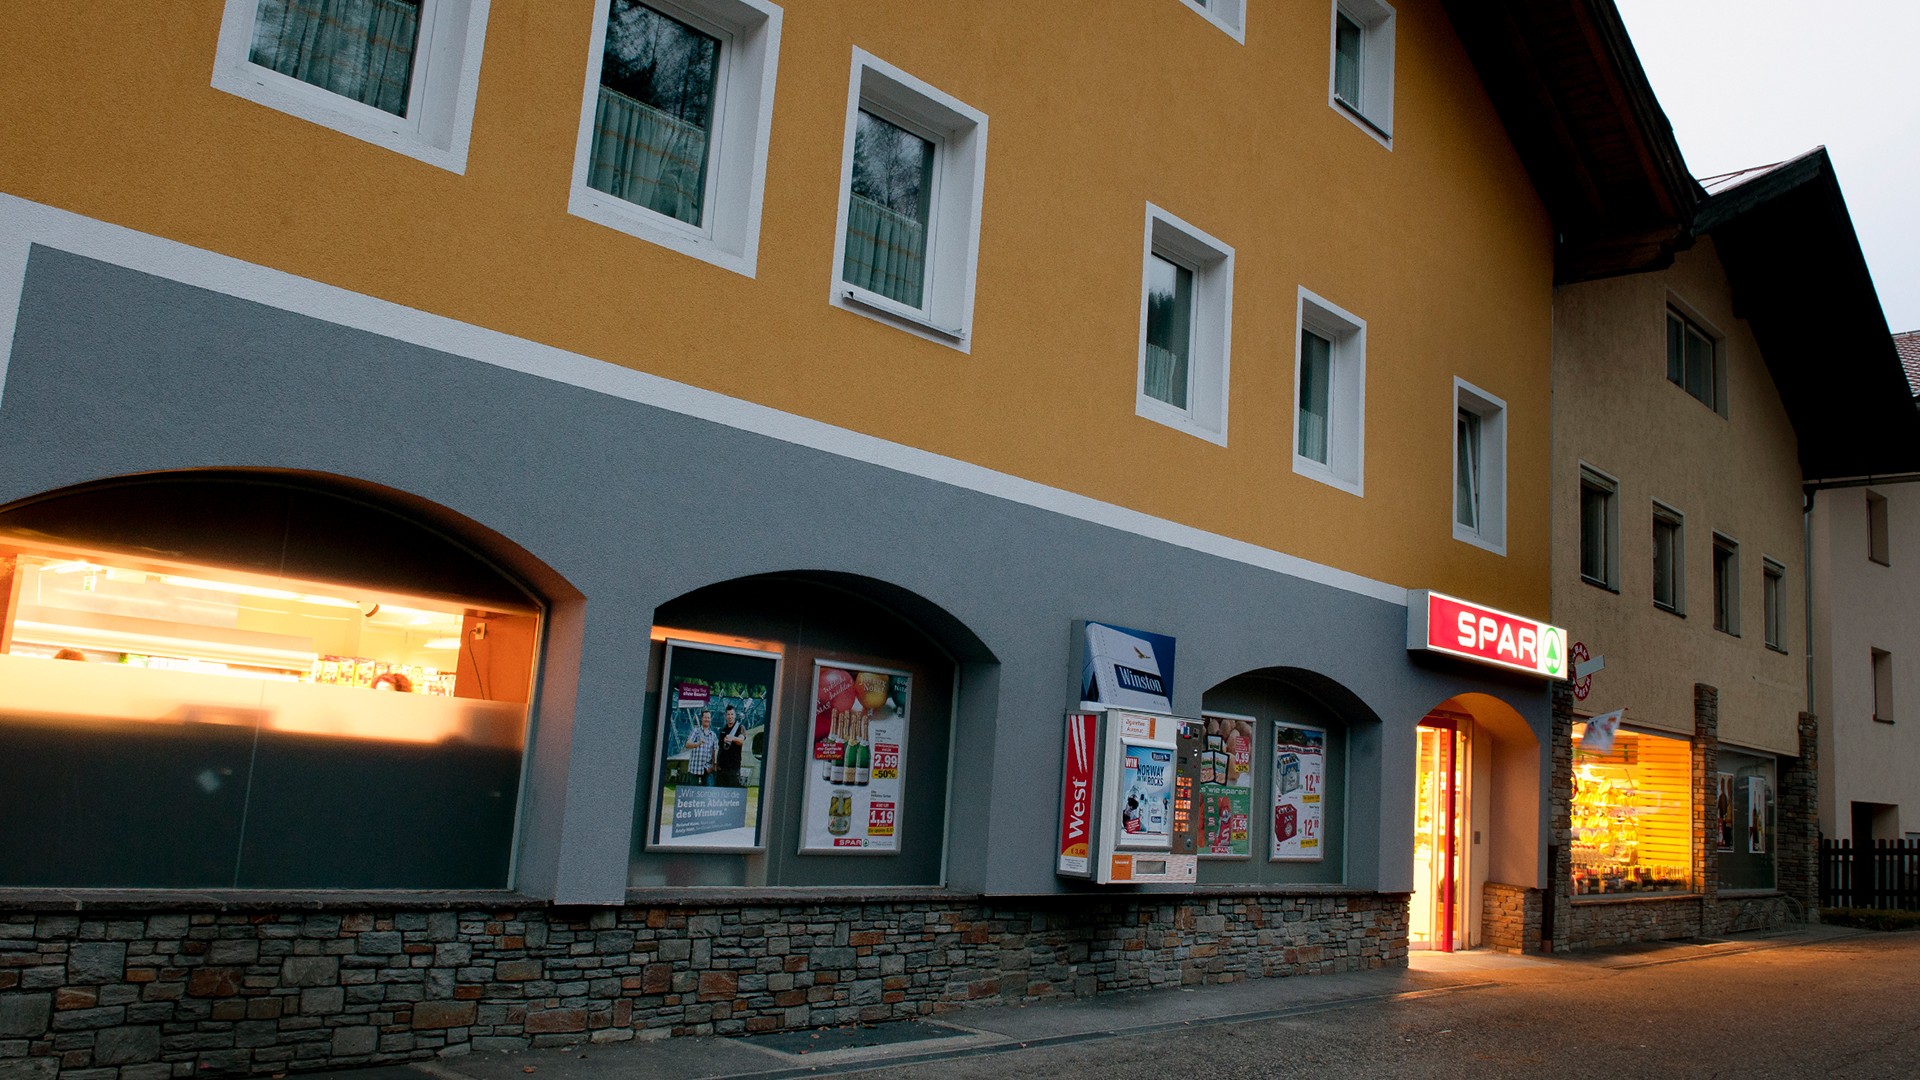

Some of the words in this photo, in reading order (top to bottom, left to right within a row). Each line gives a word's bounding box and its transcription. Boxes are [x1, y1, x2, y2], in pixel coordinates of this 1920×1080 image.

[1457, 611, 1537, 663] SPAR
[1119, 666, 1163, 693] Winston
[874, 754, 897, 769] 2,99
[874, 770, 896, 778] -50%
[1136, 764, 1164, 777] NORWAY
[677, 799, 706, 808] besten
[1069, 778, 1087, 839] West
[676, 809, 692, 819] des
[870, 810, 893, 826] 1,19
